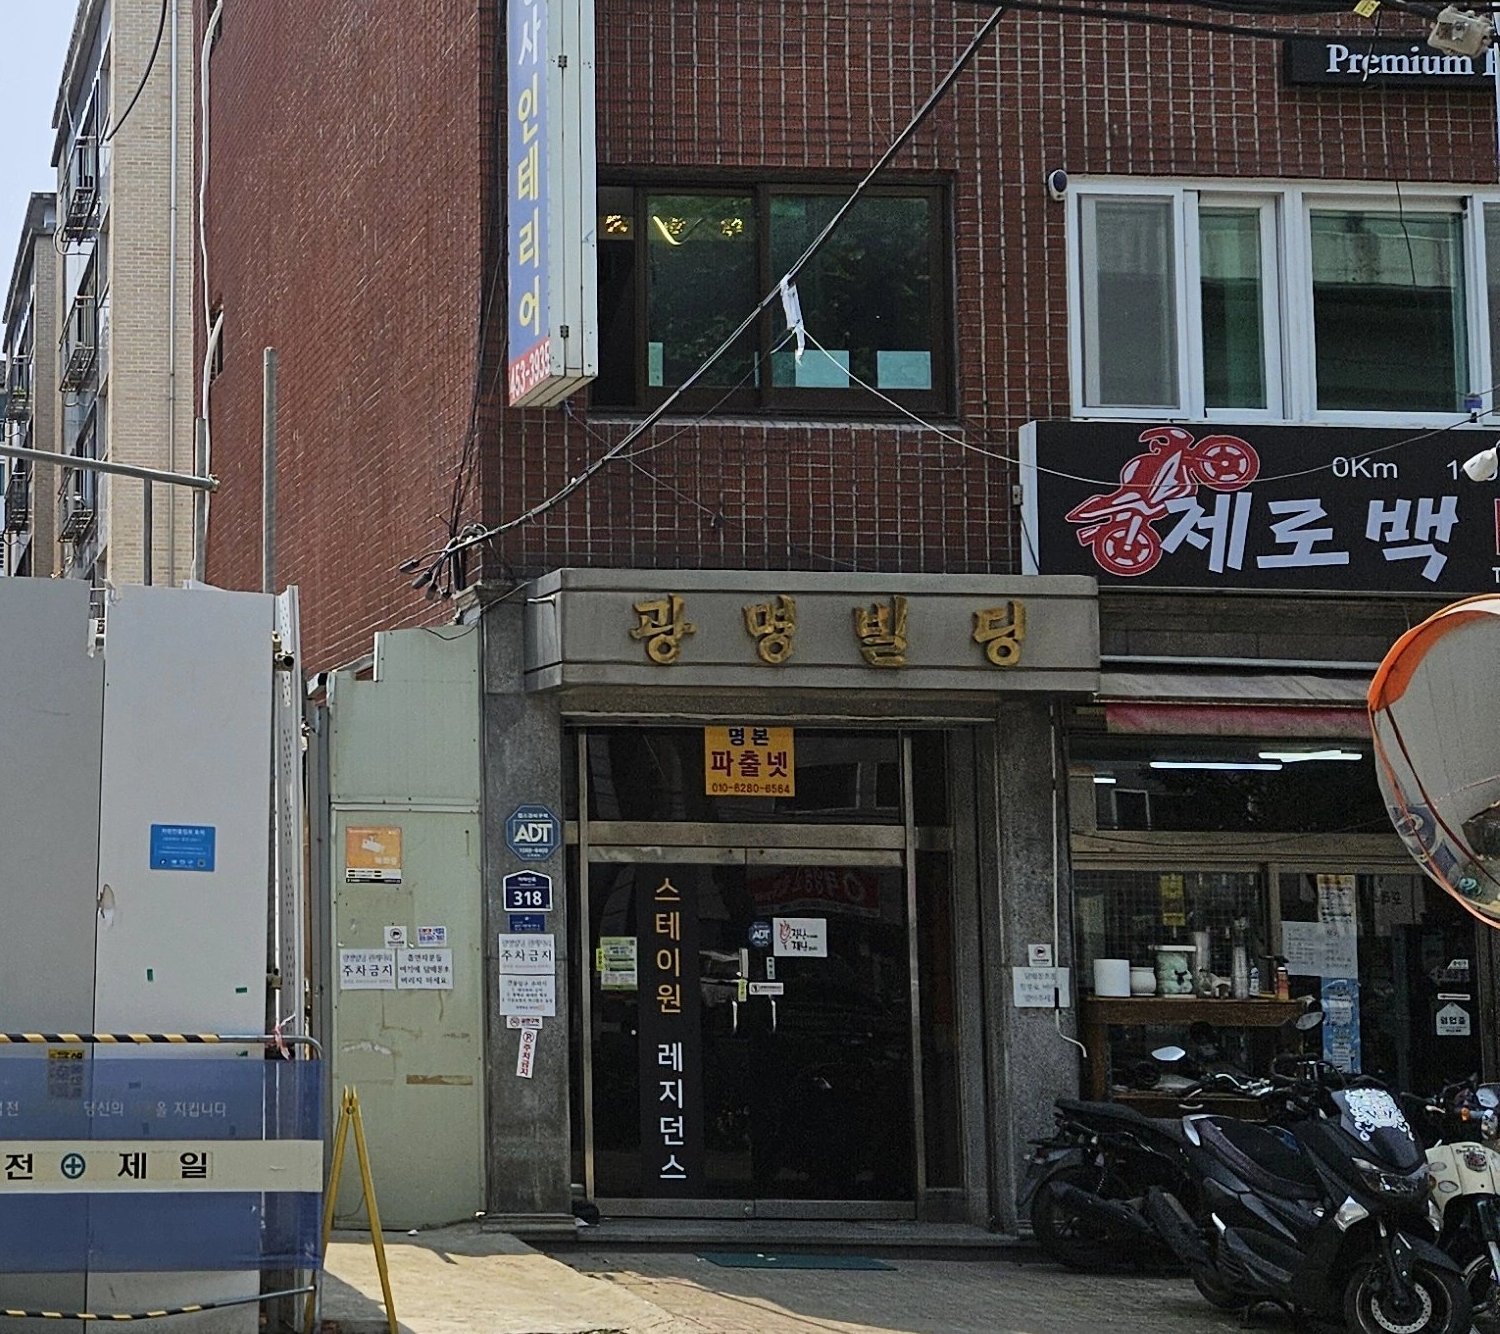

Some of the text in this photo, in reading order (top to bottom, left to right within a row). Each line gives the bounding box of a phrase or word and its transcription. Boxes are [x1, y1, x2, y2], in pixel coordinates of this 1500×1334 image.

[1326, 44, 1475, 76] Premium
[518, 72, 541, 337] 인테리어
[1332, 456, 1398, 478] 0Km
[1159, 491, 1460, 582] 제로백
[628, 592, 1027, 667] 광명빌딩
[711, 750, 788, 778] 파출넷
[513, 823, 553, 843] ADT
[513, 890, 543, 906] 318
[752, 929, 771, 940] ADT
[501, 948, 552, 962] 주차금지
[343, 964, 393, 977] 주차금지
[654, 878, 687, 1179] 스테이원 레지던스
[173, 1100, 227, 1117] 지킵니다
